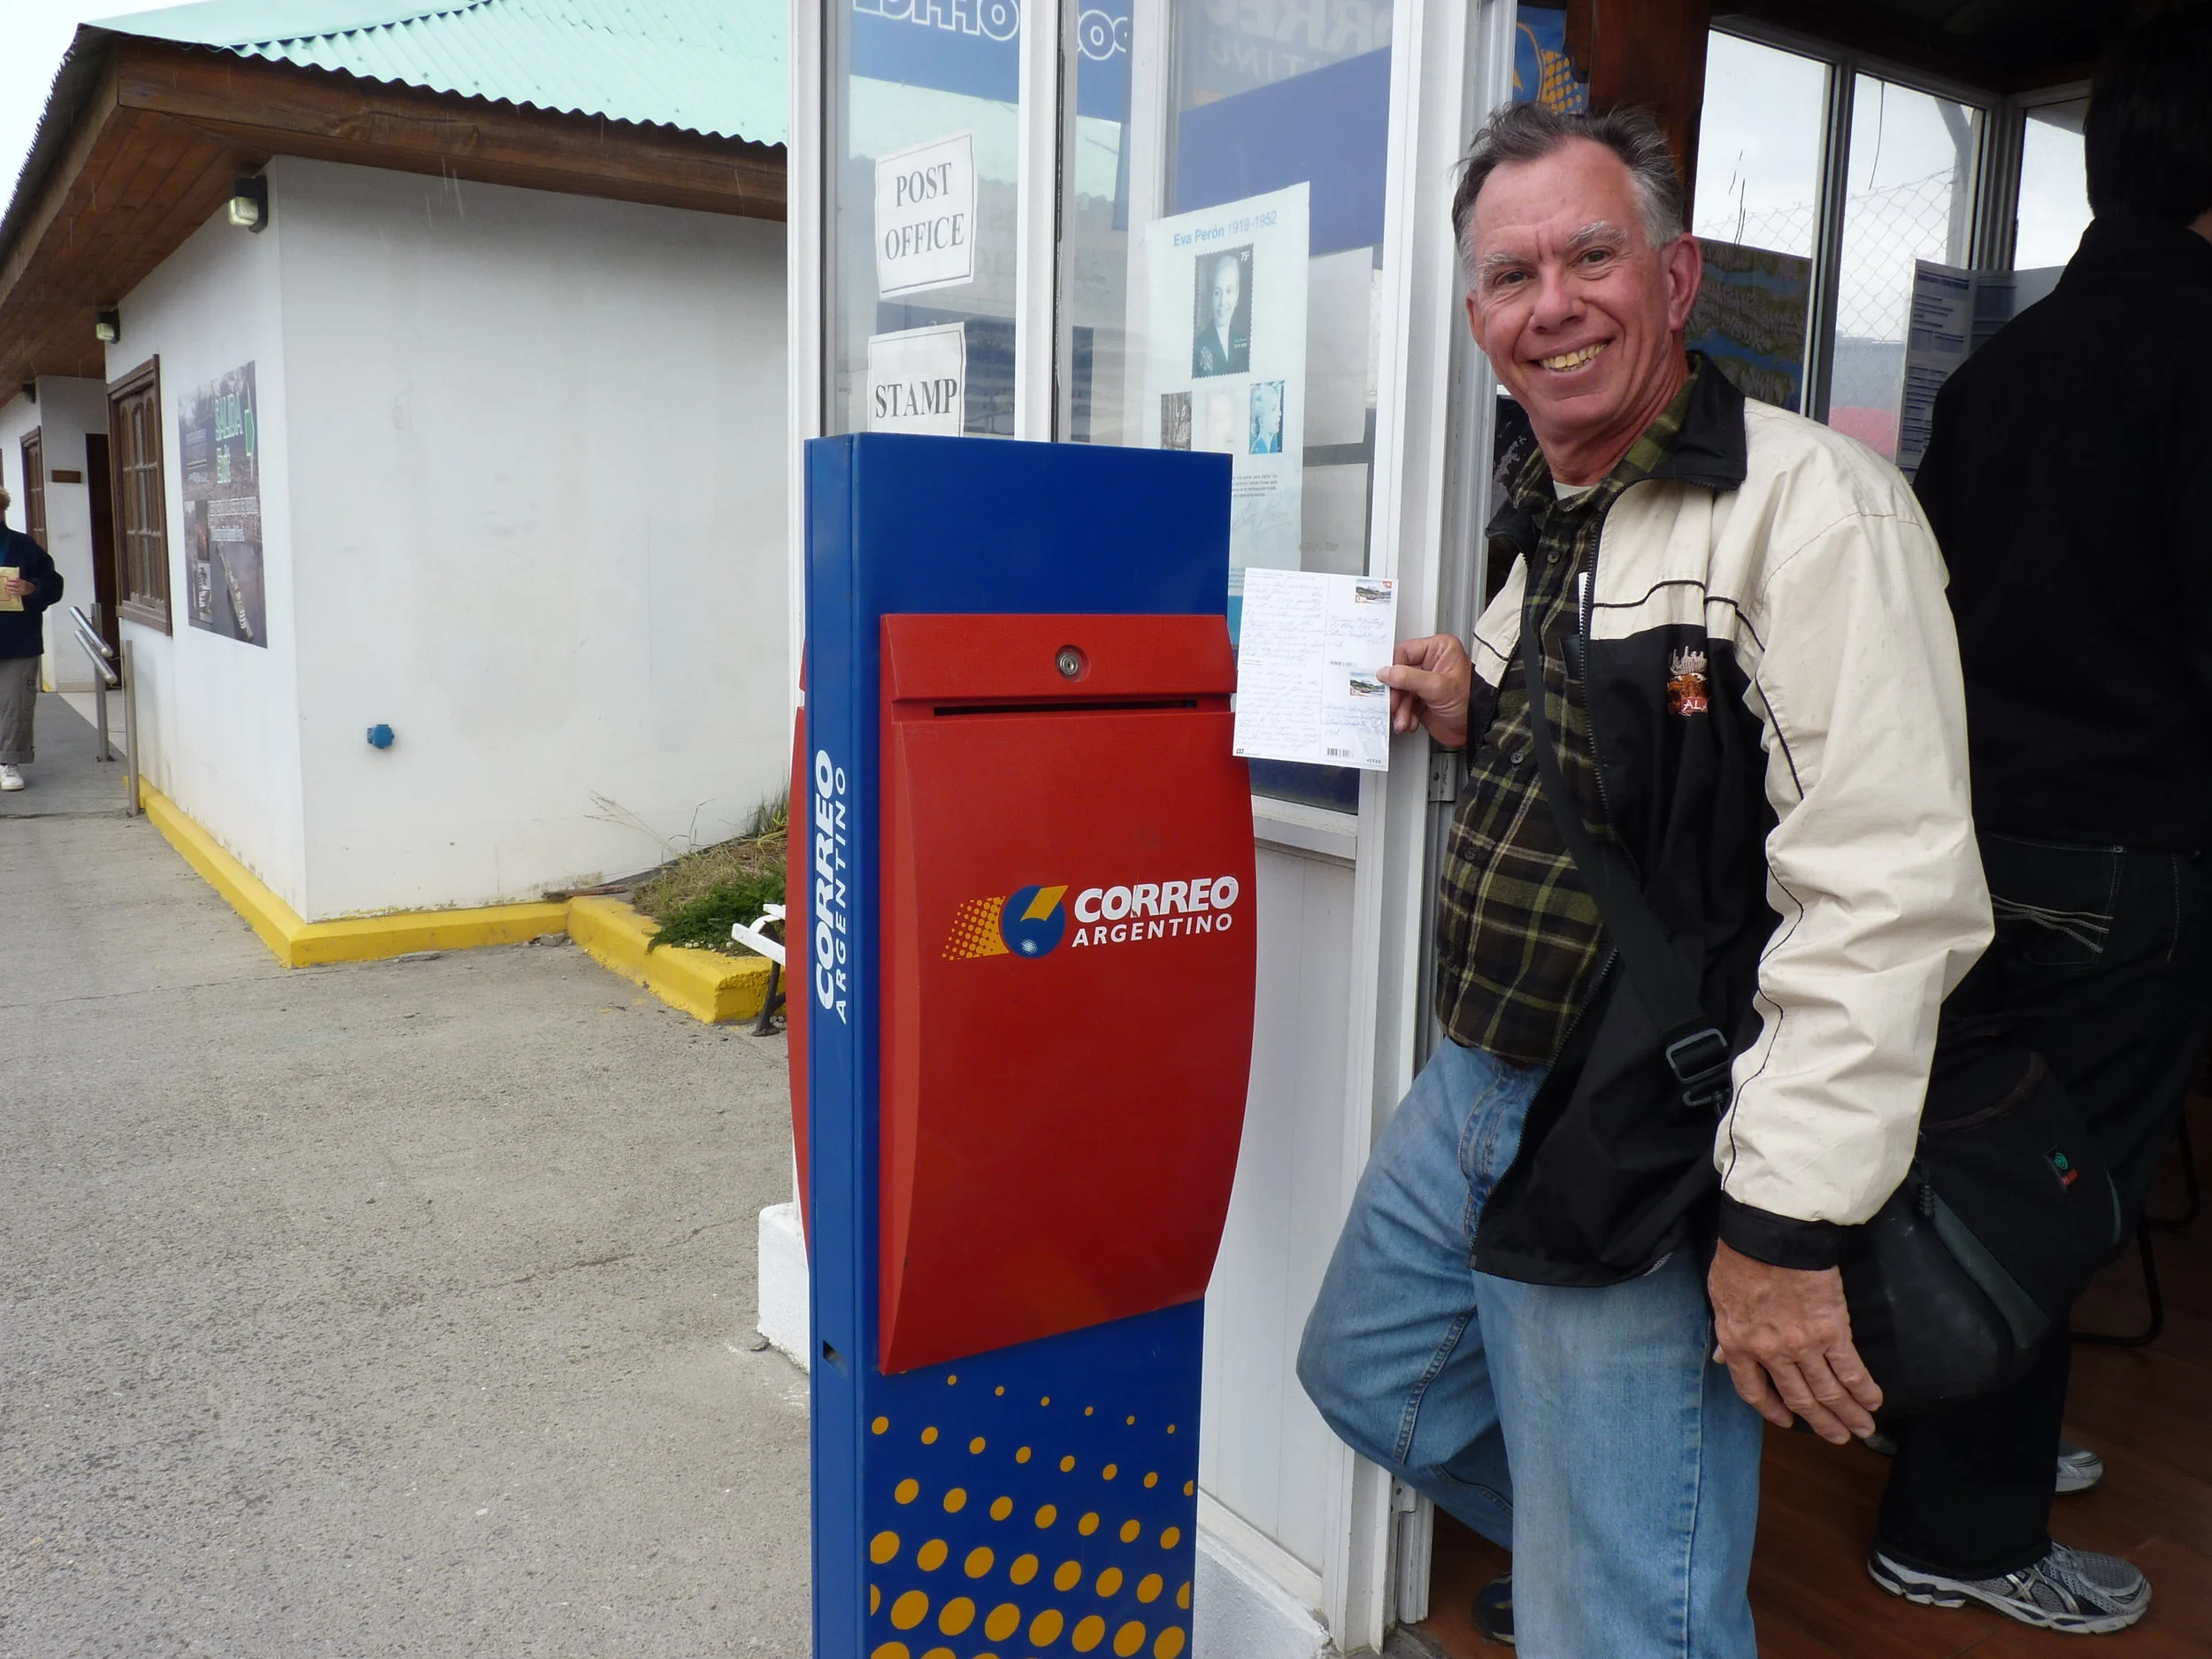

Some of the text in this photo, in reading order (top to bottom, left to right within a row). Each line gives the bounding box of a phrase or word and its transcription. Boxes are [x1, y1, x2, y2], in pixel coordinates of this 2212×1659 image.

[895, 162, 952, 207] POST
[885, 213, 964, 260] OFFICE
[1173, 211, 1278, 247] Eva Perón 1919-1952
[875, 379, 957, 419] STAMP
[815, 749, 834, 1010] CORREO
[835, 767, 847, 1025] ARGENTINO
[1074, 876, 1239, 923] CORREO
[1071, 913, 1233, 948] ARGENTINO
